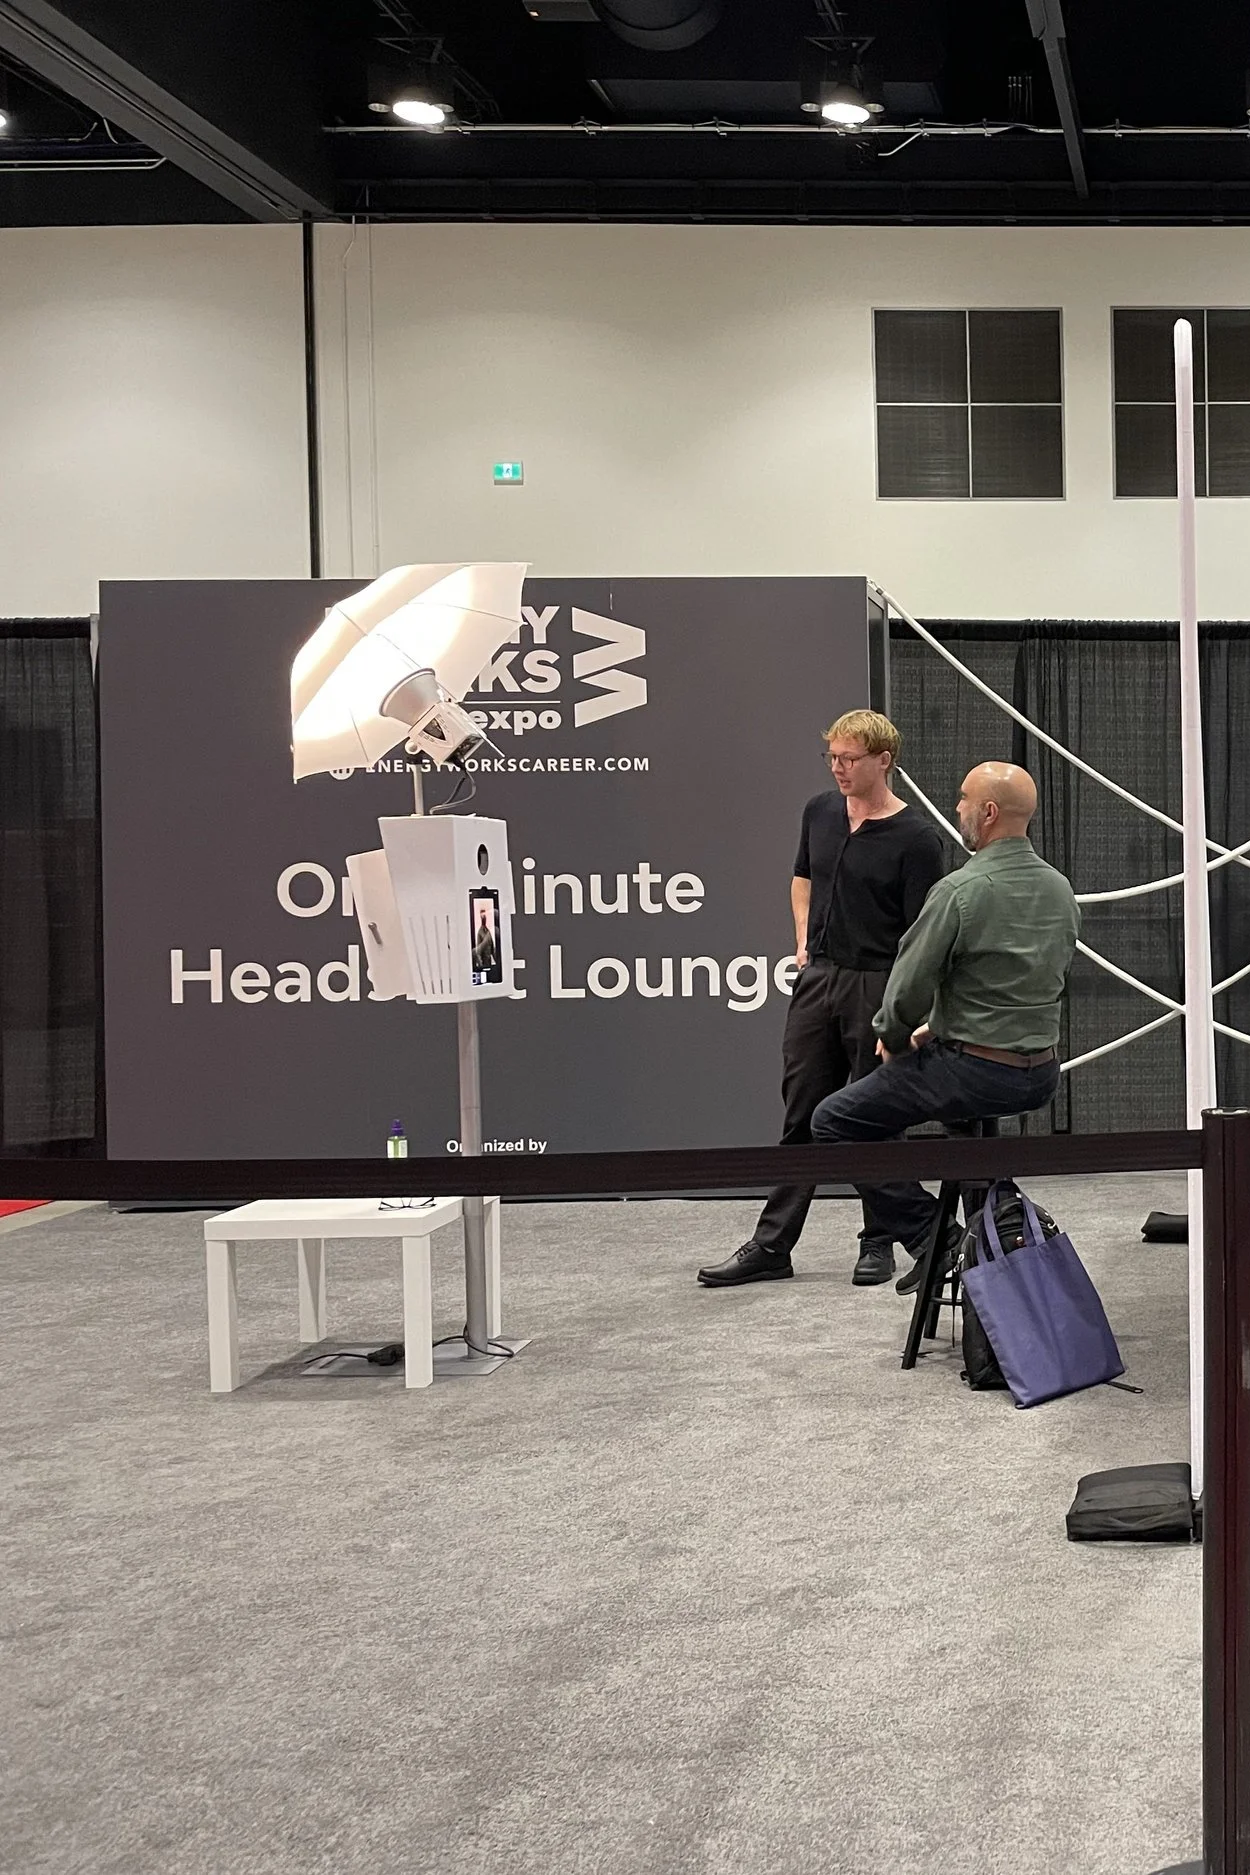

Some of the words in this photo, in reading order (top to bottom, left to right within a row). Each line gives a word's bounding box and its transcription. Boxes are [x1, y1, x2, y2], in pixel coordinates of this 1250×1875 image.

[467, 710, 562, 736] expo
[365, 757, 650, 773] NEGORKSCAREER.COM
[508, 857, 705, 916] inute
[549, 944, 799, 1012] Lounge
[446, 1139, 525, 1153] Onized
[529, 1138, 548, 1154] by
